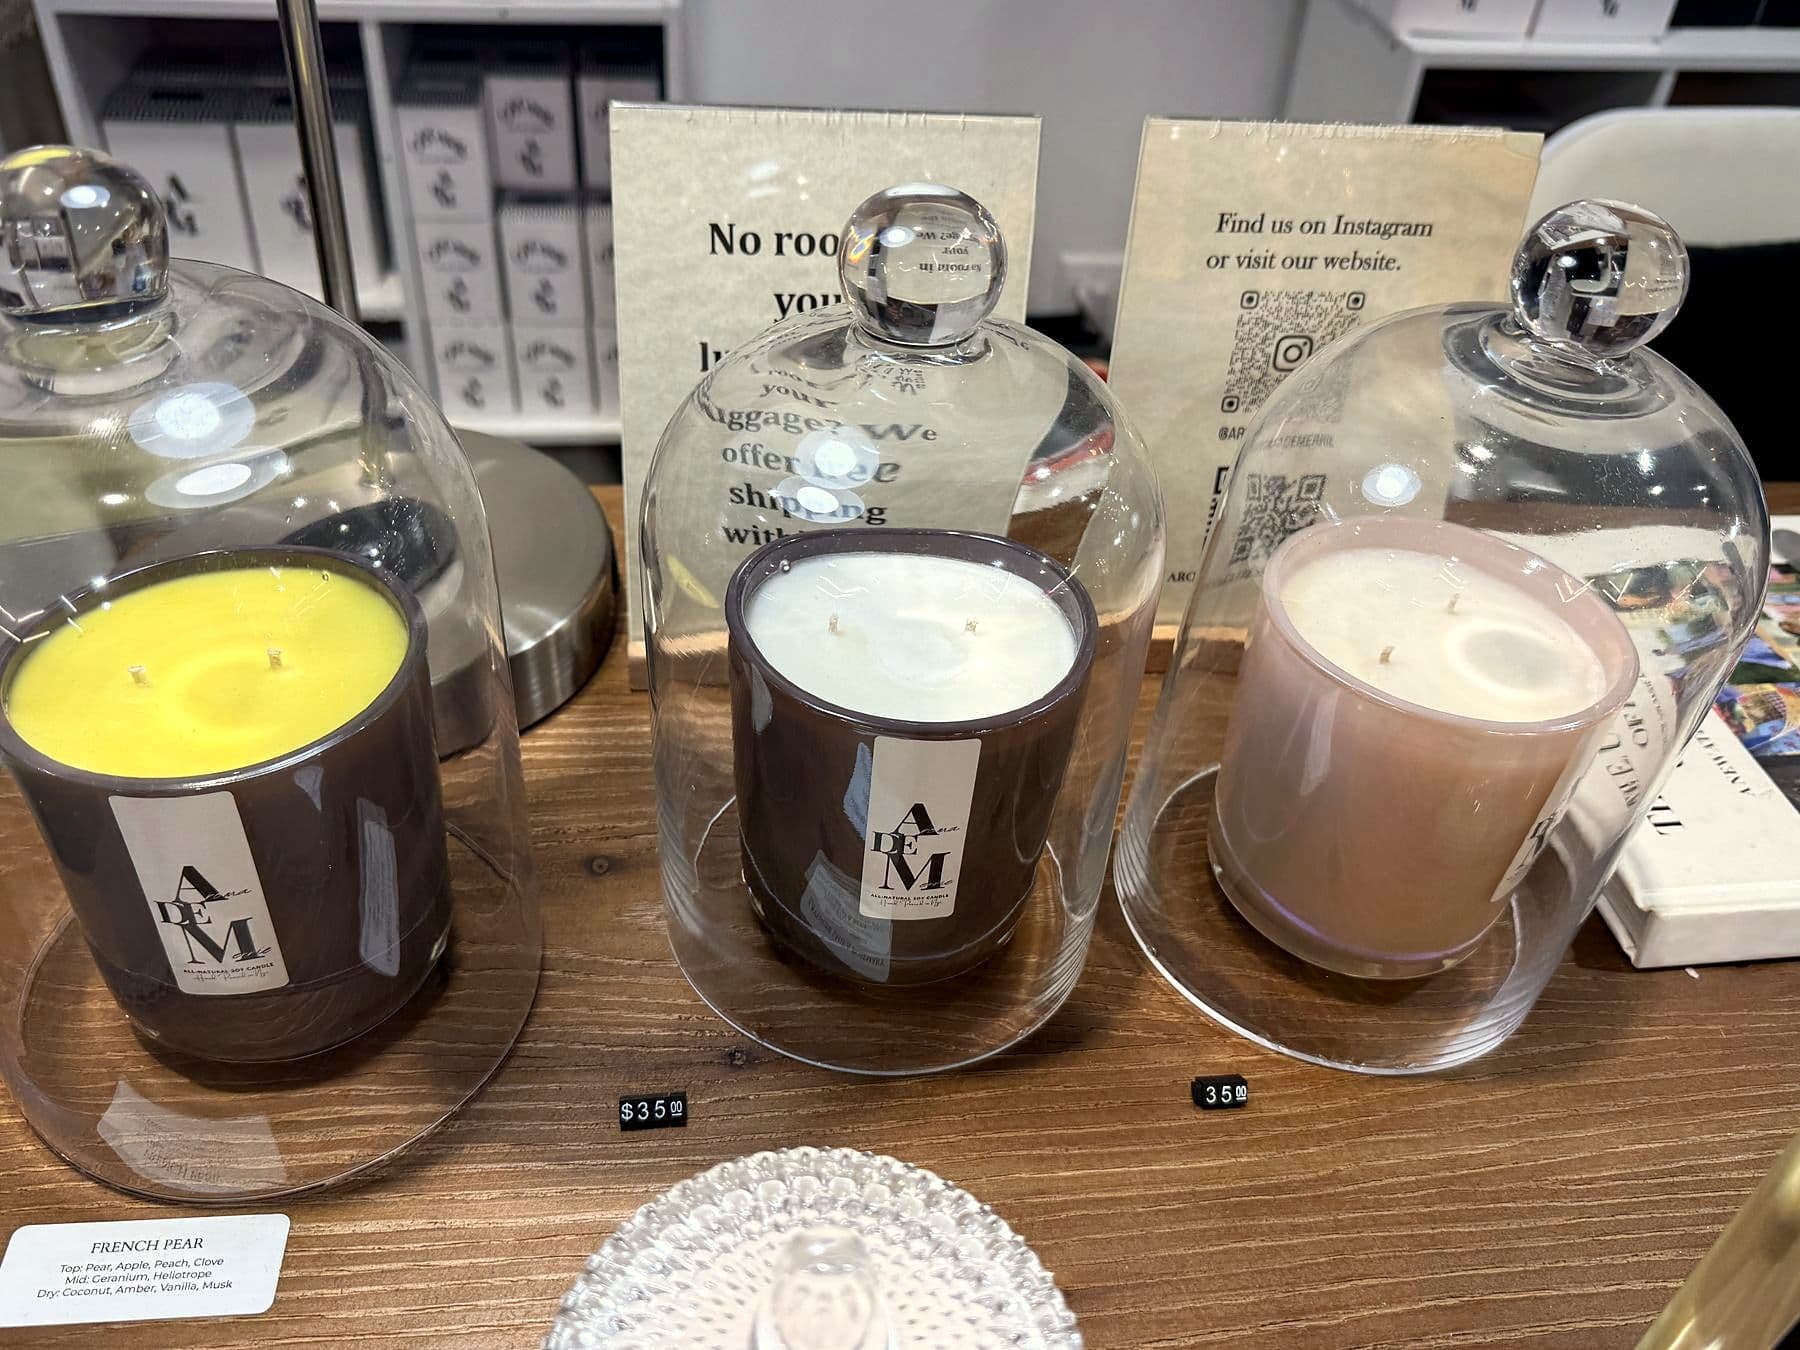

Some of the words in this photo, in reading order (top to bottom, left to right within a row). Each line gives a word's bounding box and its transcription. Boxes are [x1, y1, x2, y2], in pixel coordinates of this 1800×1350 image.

[1215, 212, 1265, 234] Find
[1271, 219, 1293, 235] us
[1299, 219, 1326, 236] on
[1332, 214, 1434, 240] Instagram
[709, 223, 762, 256] No
[774, 232, 840, 257] roo
[1206, 254, 1230, 269] or
[1236, 249, 1277, 270] visit
[1280, 256, 1317, 270] our
[1323, 250, 1401, 272] website.
[774, 293, 842, 323] you
[728, 482, 888, 526] shipng
[926, 893, 949, 901] CANDLE
[246, 962, 274, 971] CANDLE
[91, 1239, 160, 1254] FRENCH
[163, 1237, 204, 1252] PEAR
[60, 1264, 84, 1275] Top:
[85, 1262, 114, 1274] Pear,
[115, 1260, 151, 1273] Apple,
[154, 1258, 190, 1270] Peach,
[193, 1257, 225, 1268] Clove
[65, 1275, 90, 1286] Mid:
[91, 1272, 150, 1285] Geranium,
[153, 1269, 212, 1282] Heliotrope
[37, 1289, 61, 1300] Dry:
[62, 1286, 114, 1298] Coconut,
[116, 1284, 157, 1296] Amber,
[160, 1282, 200, 1293] Vanilla,
[202, 1279, 233, 1291] Musk
